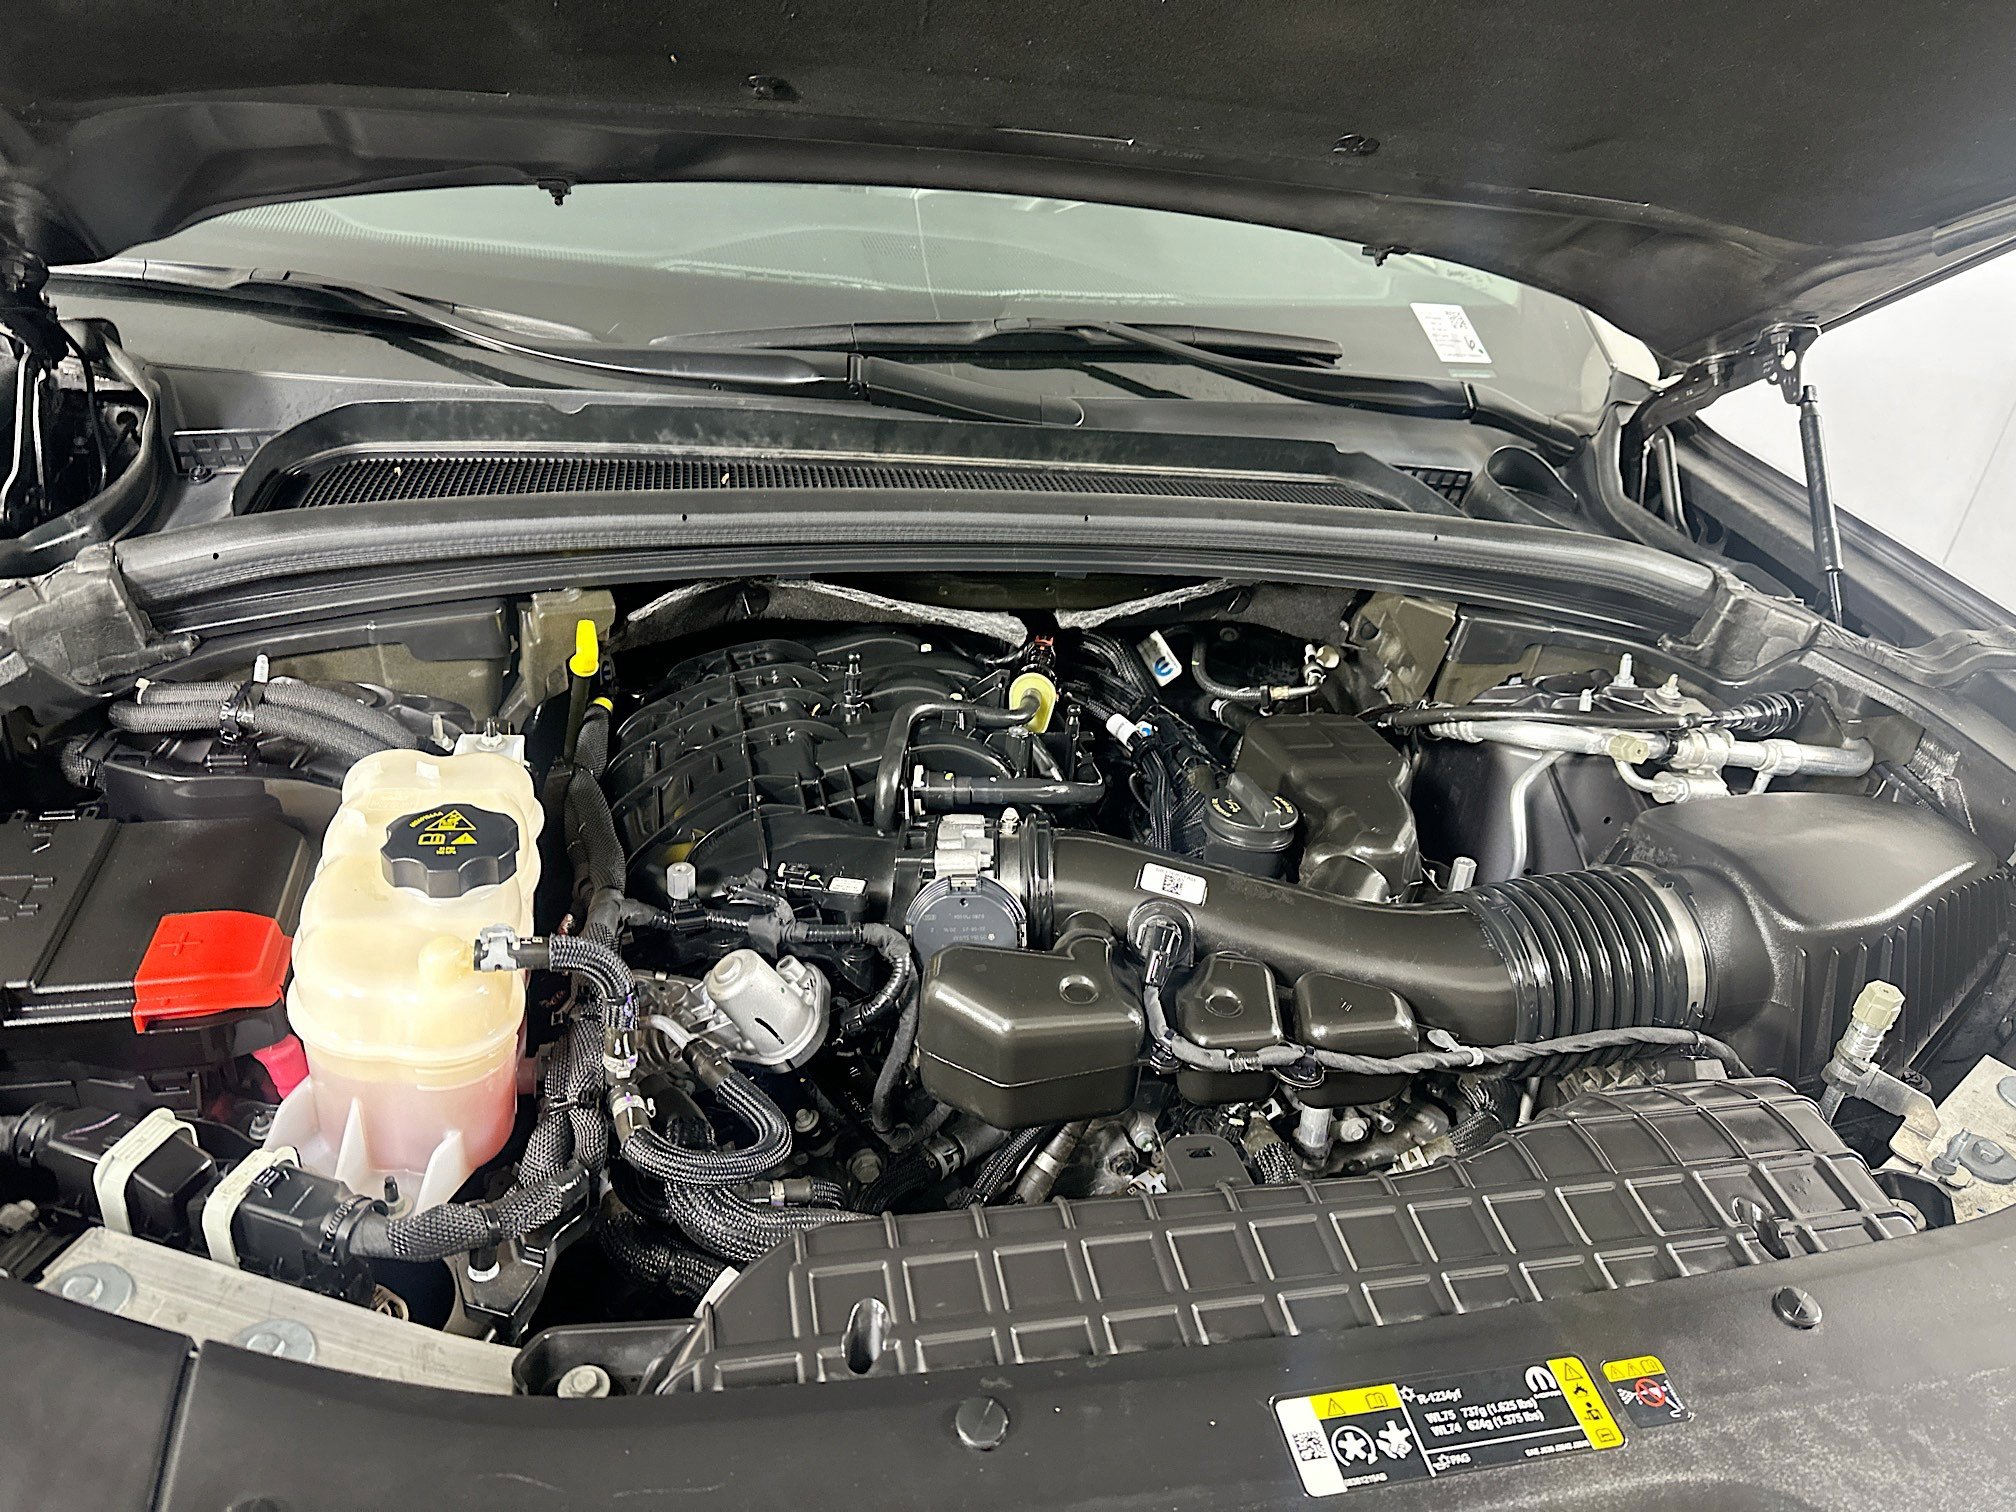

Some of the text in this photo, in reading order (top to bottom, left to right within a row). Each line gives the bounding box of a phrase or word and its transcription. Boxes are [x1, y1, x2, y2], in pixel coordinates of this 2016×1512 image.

[1416, 1388, 1463, 1405] R-1234yf
[1424, 1397, 1539, 1424] WL75 737g (1.625 lbs)
[1430, 1409, 1545, 1437] WL74 624g (1.375 lbs)
[1450, 1452, 1472, 1466] PAG
